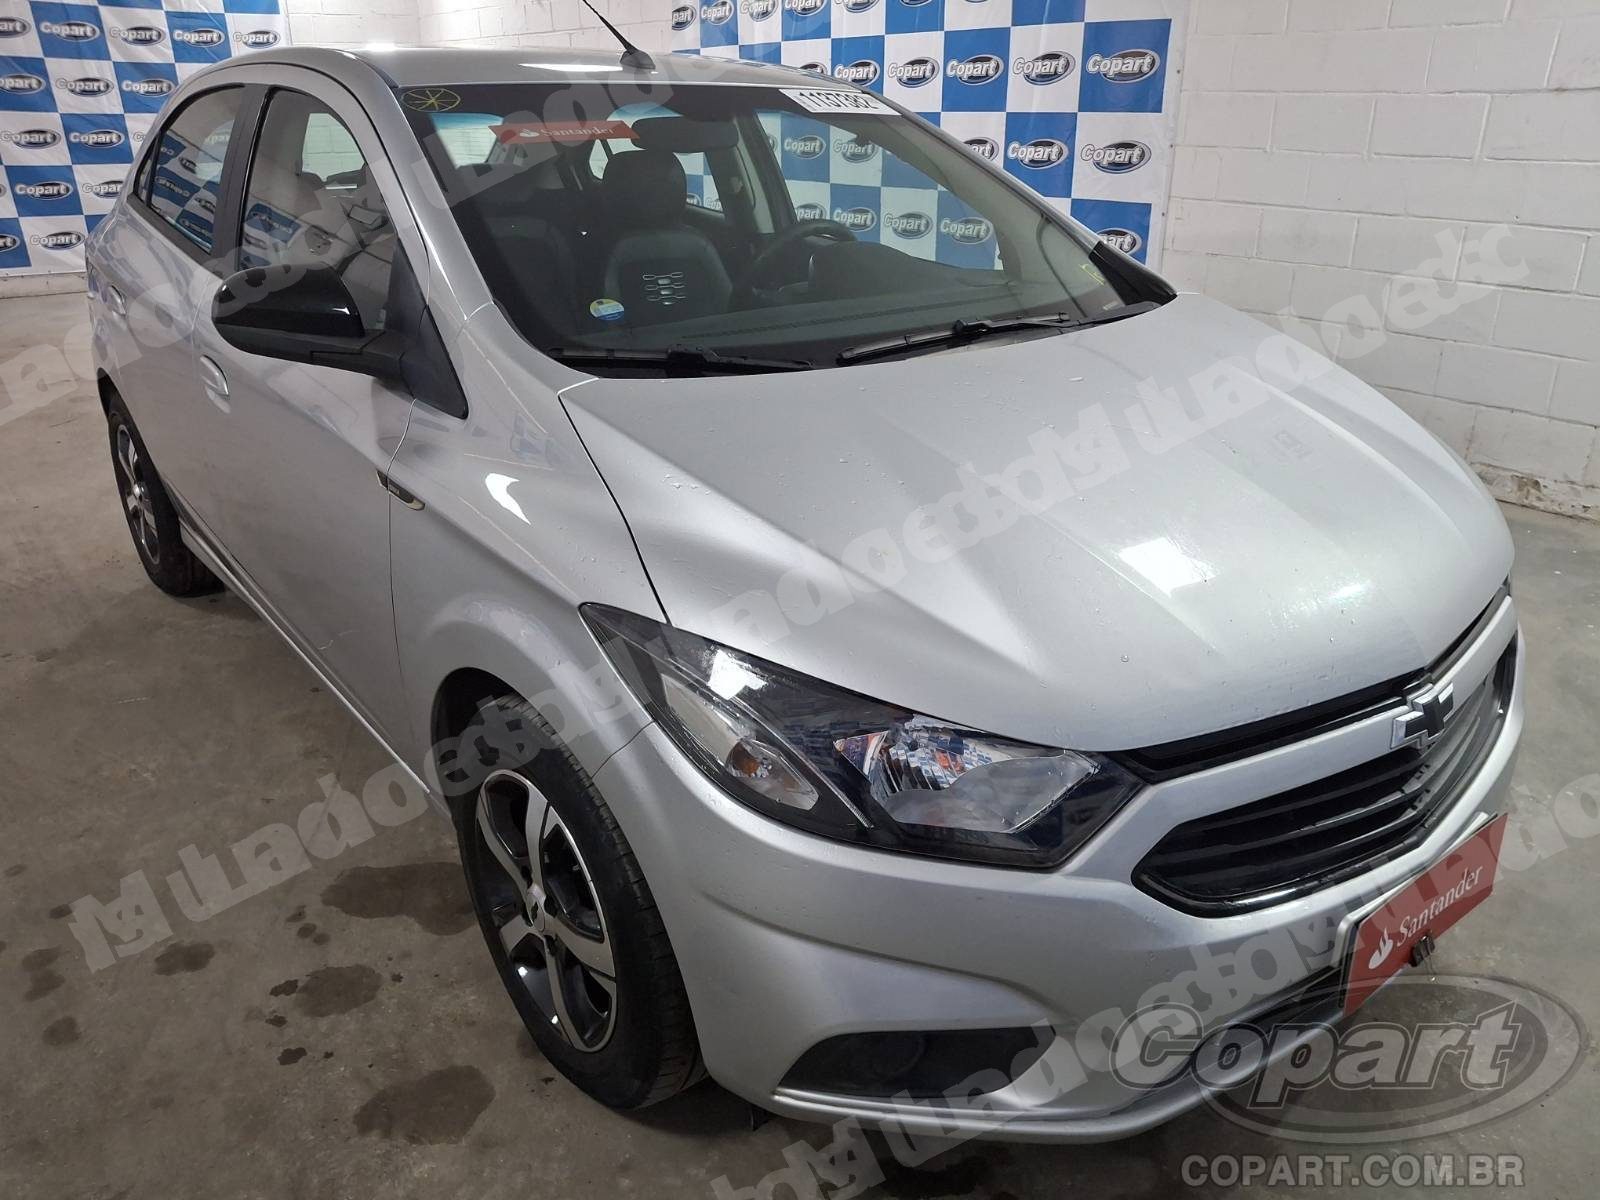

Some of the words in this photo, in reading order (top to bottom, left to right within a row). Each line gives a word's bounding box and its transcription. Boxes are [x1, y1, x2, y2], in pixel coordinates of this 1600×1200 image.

[701, 3, 730, 21] Copart
[740, 0, 773, 16] Copart
[672, 9, 691, 24] part
[40, 22, 93, 37] Copart
[110, 27, 159, 42] Copart
[173, 29, 220, 43] Copart
[233, 32, 275, 44] Copart
[834, 62, 874, 81] Copart
[888, 60, 934, 81] Copart
[946, 57, 997, 80] Copart
[1013, 54, 1065, 77] Copart
[1086, 52, 1153, 77] Copart
[55, 78, 107, 92] Copart
[122, 80, 168, 95] Copart
[1, 131, 53, 144] Copart
[69, 131, 118, 145] Copart
[541, 126, 616, 137] Santander
[784, 137, 820, 157] Copart
[1007, 141, 1059, 162] Copart
[1081, 144, 1142, 166] Copart
[15, 182, 67, 198] Copart
[82, 182, 122, 197] Copar
[797, 207, 822, 222] part
[833, 208, 872, 228] Copart
[884, 212, 927, 233] Copart
[940, 219, 987, 242] Copart
[30, 233, 78, 248] Copart
[1397, 865, 1483, 947] Santander
